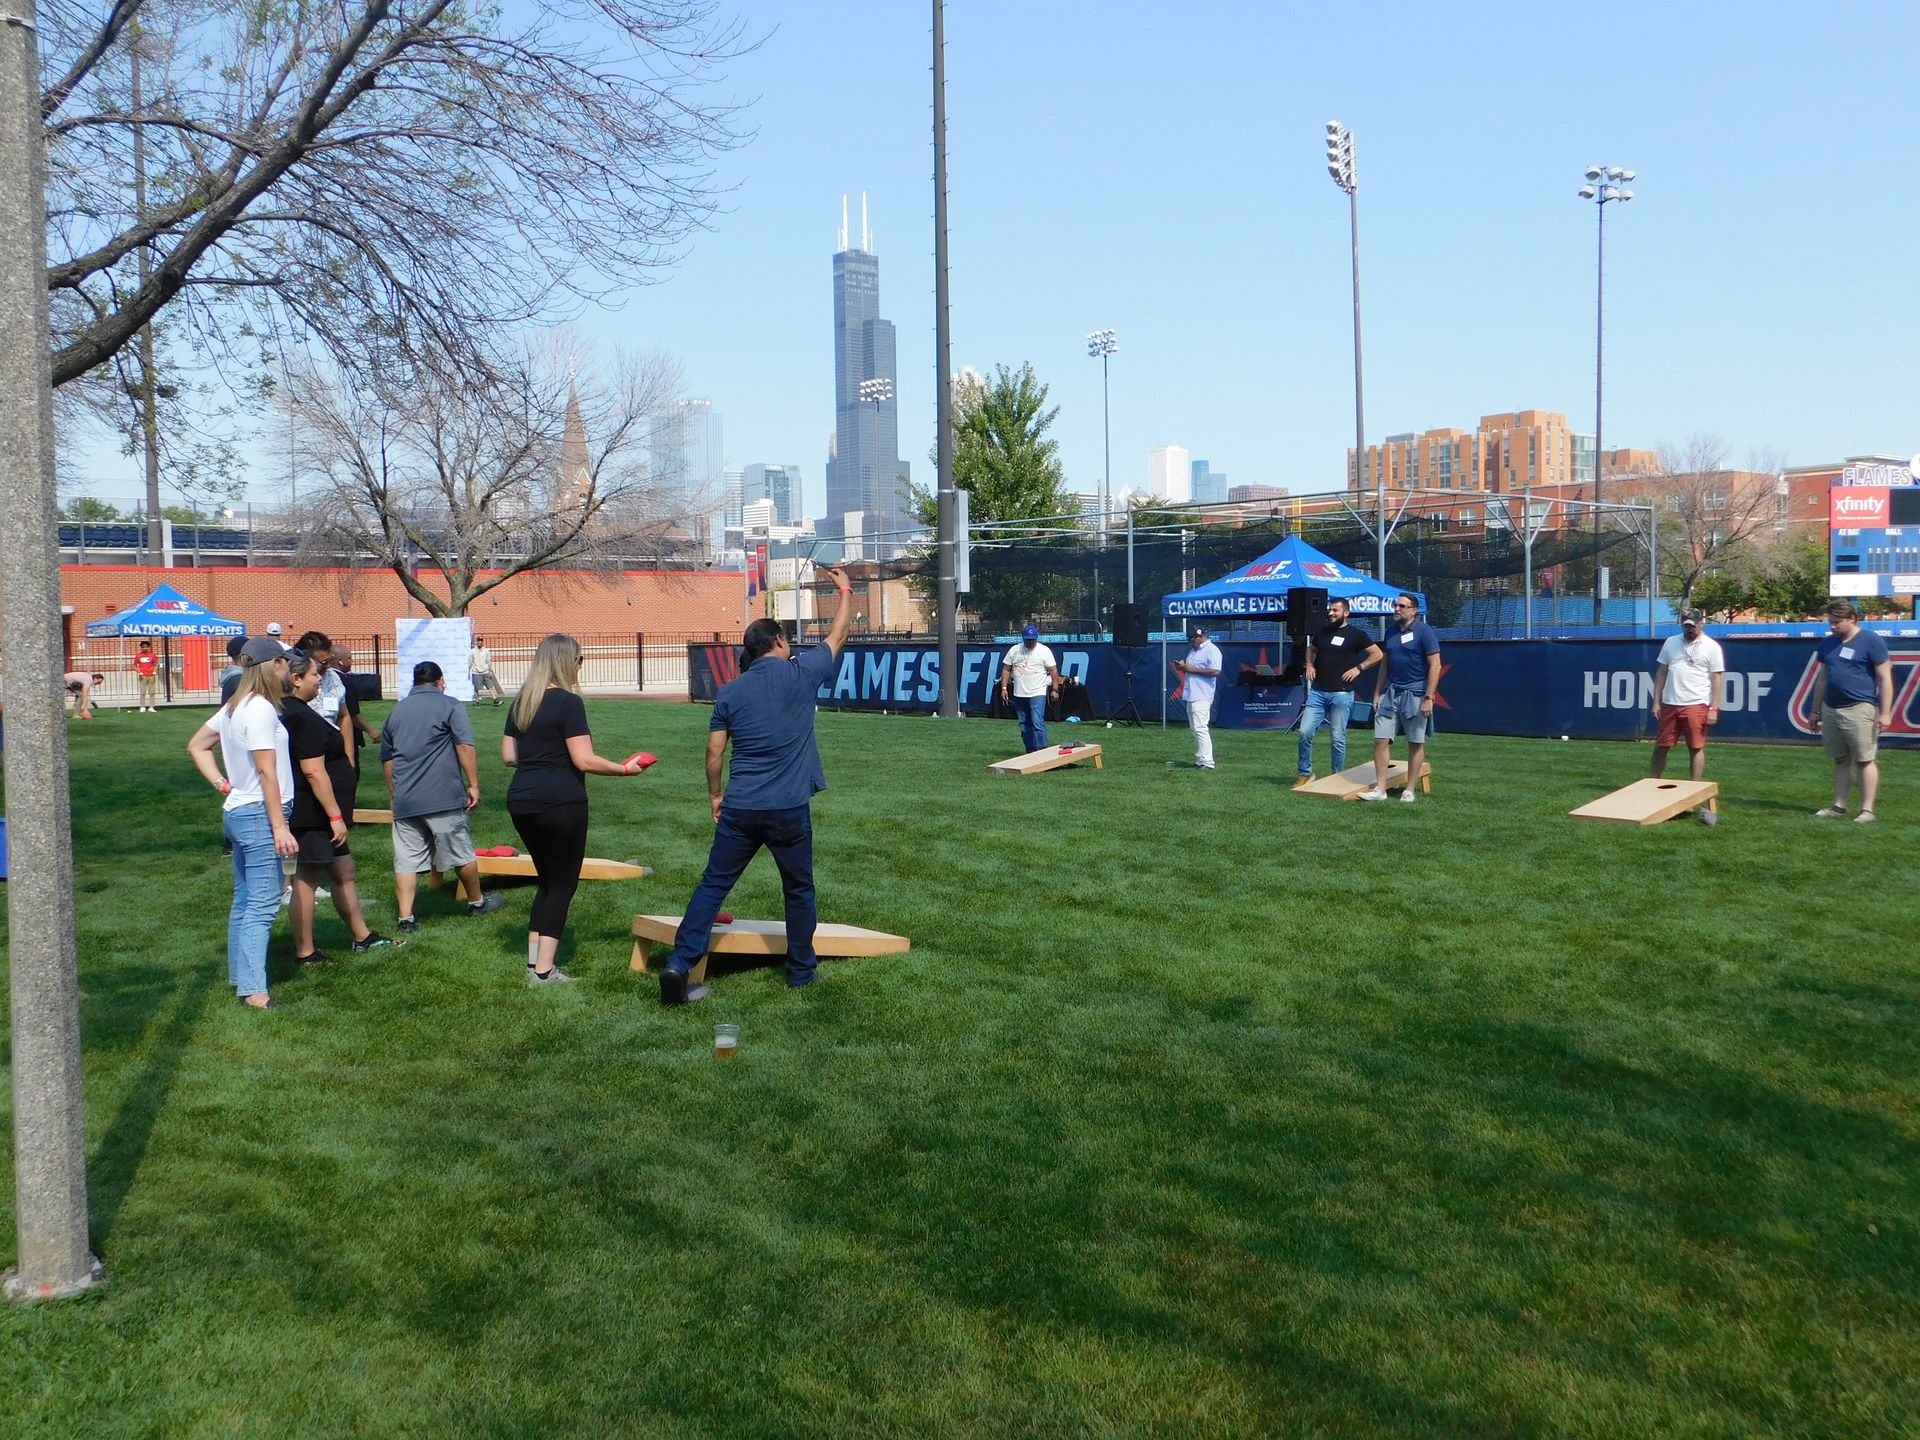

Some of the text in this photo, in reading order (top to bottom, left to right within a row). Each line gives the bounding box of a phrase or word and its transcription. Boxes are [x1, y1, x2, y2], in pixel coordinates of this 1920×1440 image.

[1843, 467, 1911, 486] FLAMES
[1835, 495, 1884, 513] xfinity
[1885, 528, 1902, 536] BALL
[1243, 560, 1293, 577] WCF
[1302, 562, 1342, 578] WCF
[155, 601, 190, 610] WCF
[1168, 596, 1288, 616] CHARITABLE EVEN
[123, 624, 198, 635] NATIONWIDE
[200, 625, 243, 635] EVENTS
[959, 651, 1089, 704] FID
[1718, 672, 1774, 711] OF
